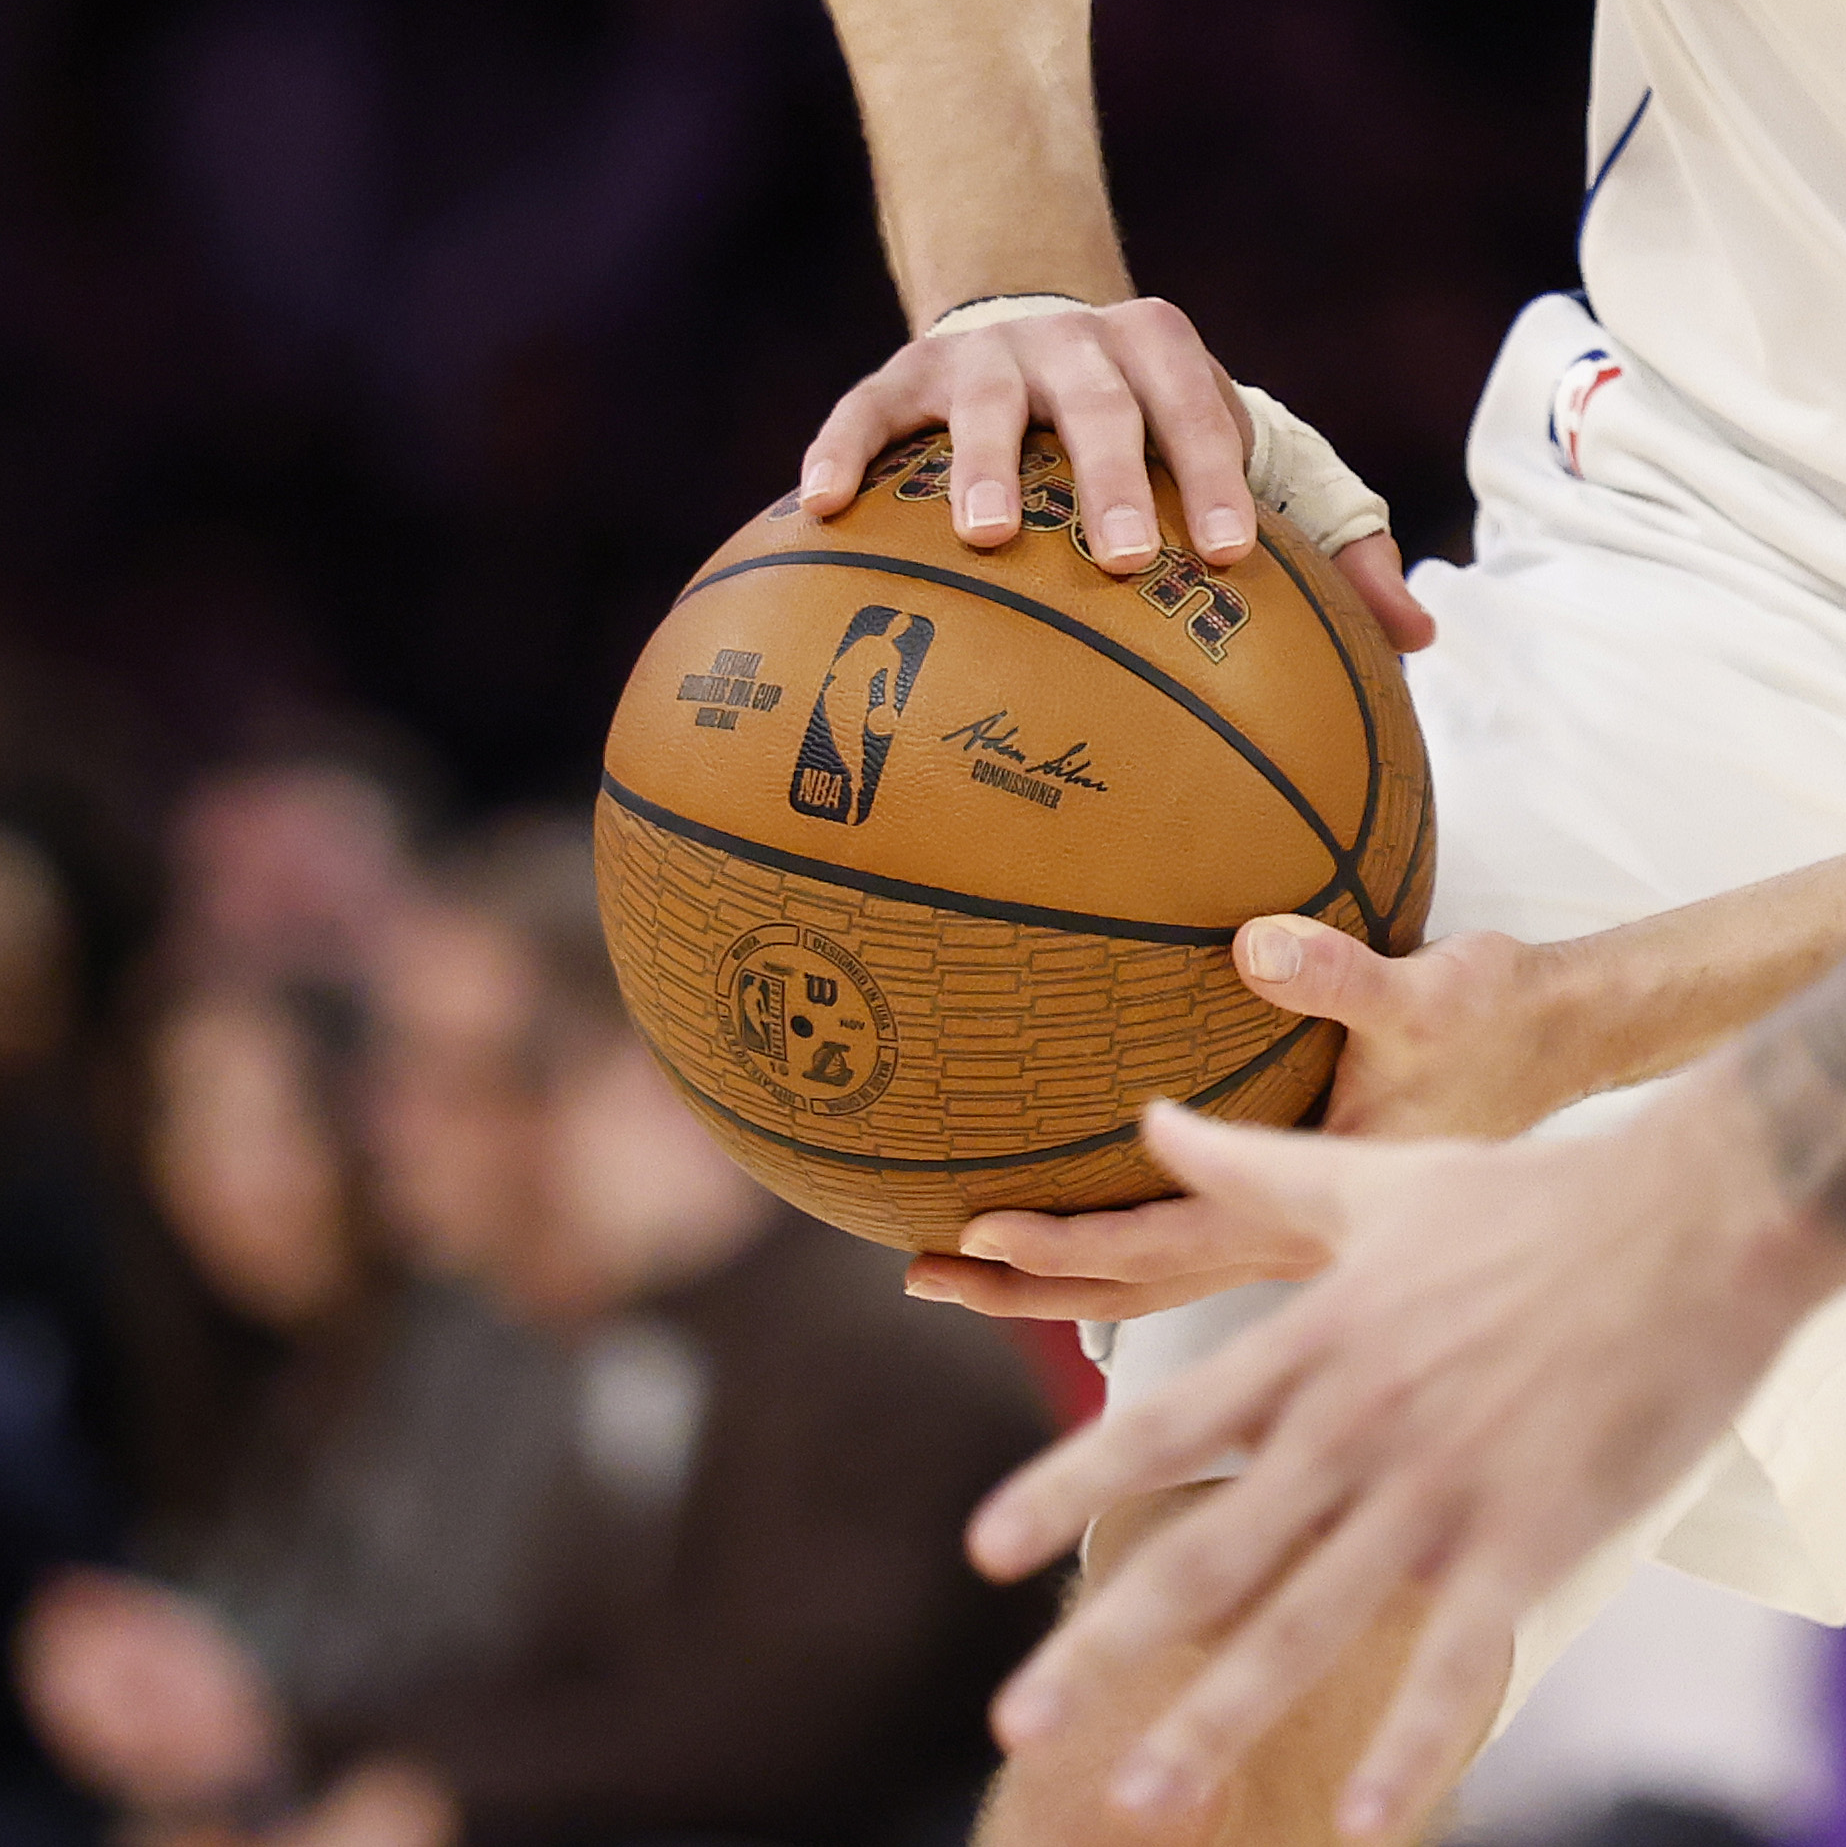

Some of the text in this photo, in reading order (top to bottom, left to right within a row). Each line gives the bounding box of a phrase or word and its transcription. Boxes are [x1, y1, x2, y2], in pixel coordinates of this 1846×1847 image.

[797, 767, 843, 809] NBA
[971, 757, 1064, 810] COMMISSIONER
[812, 936, 869, 986] DESIGNED
